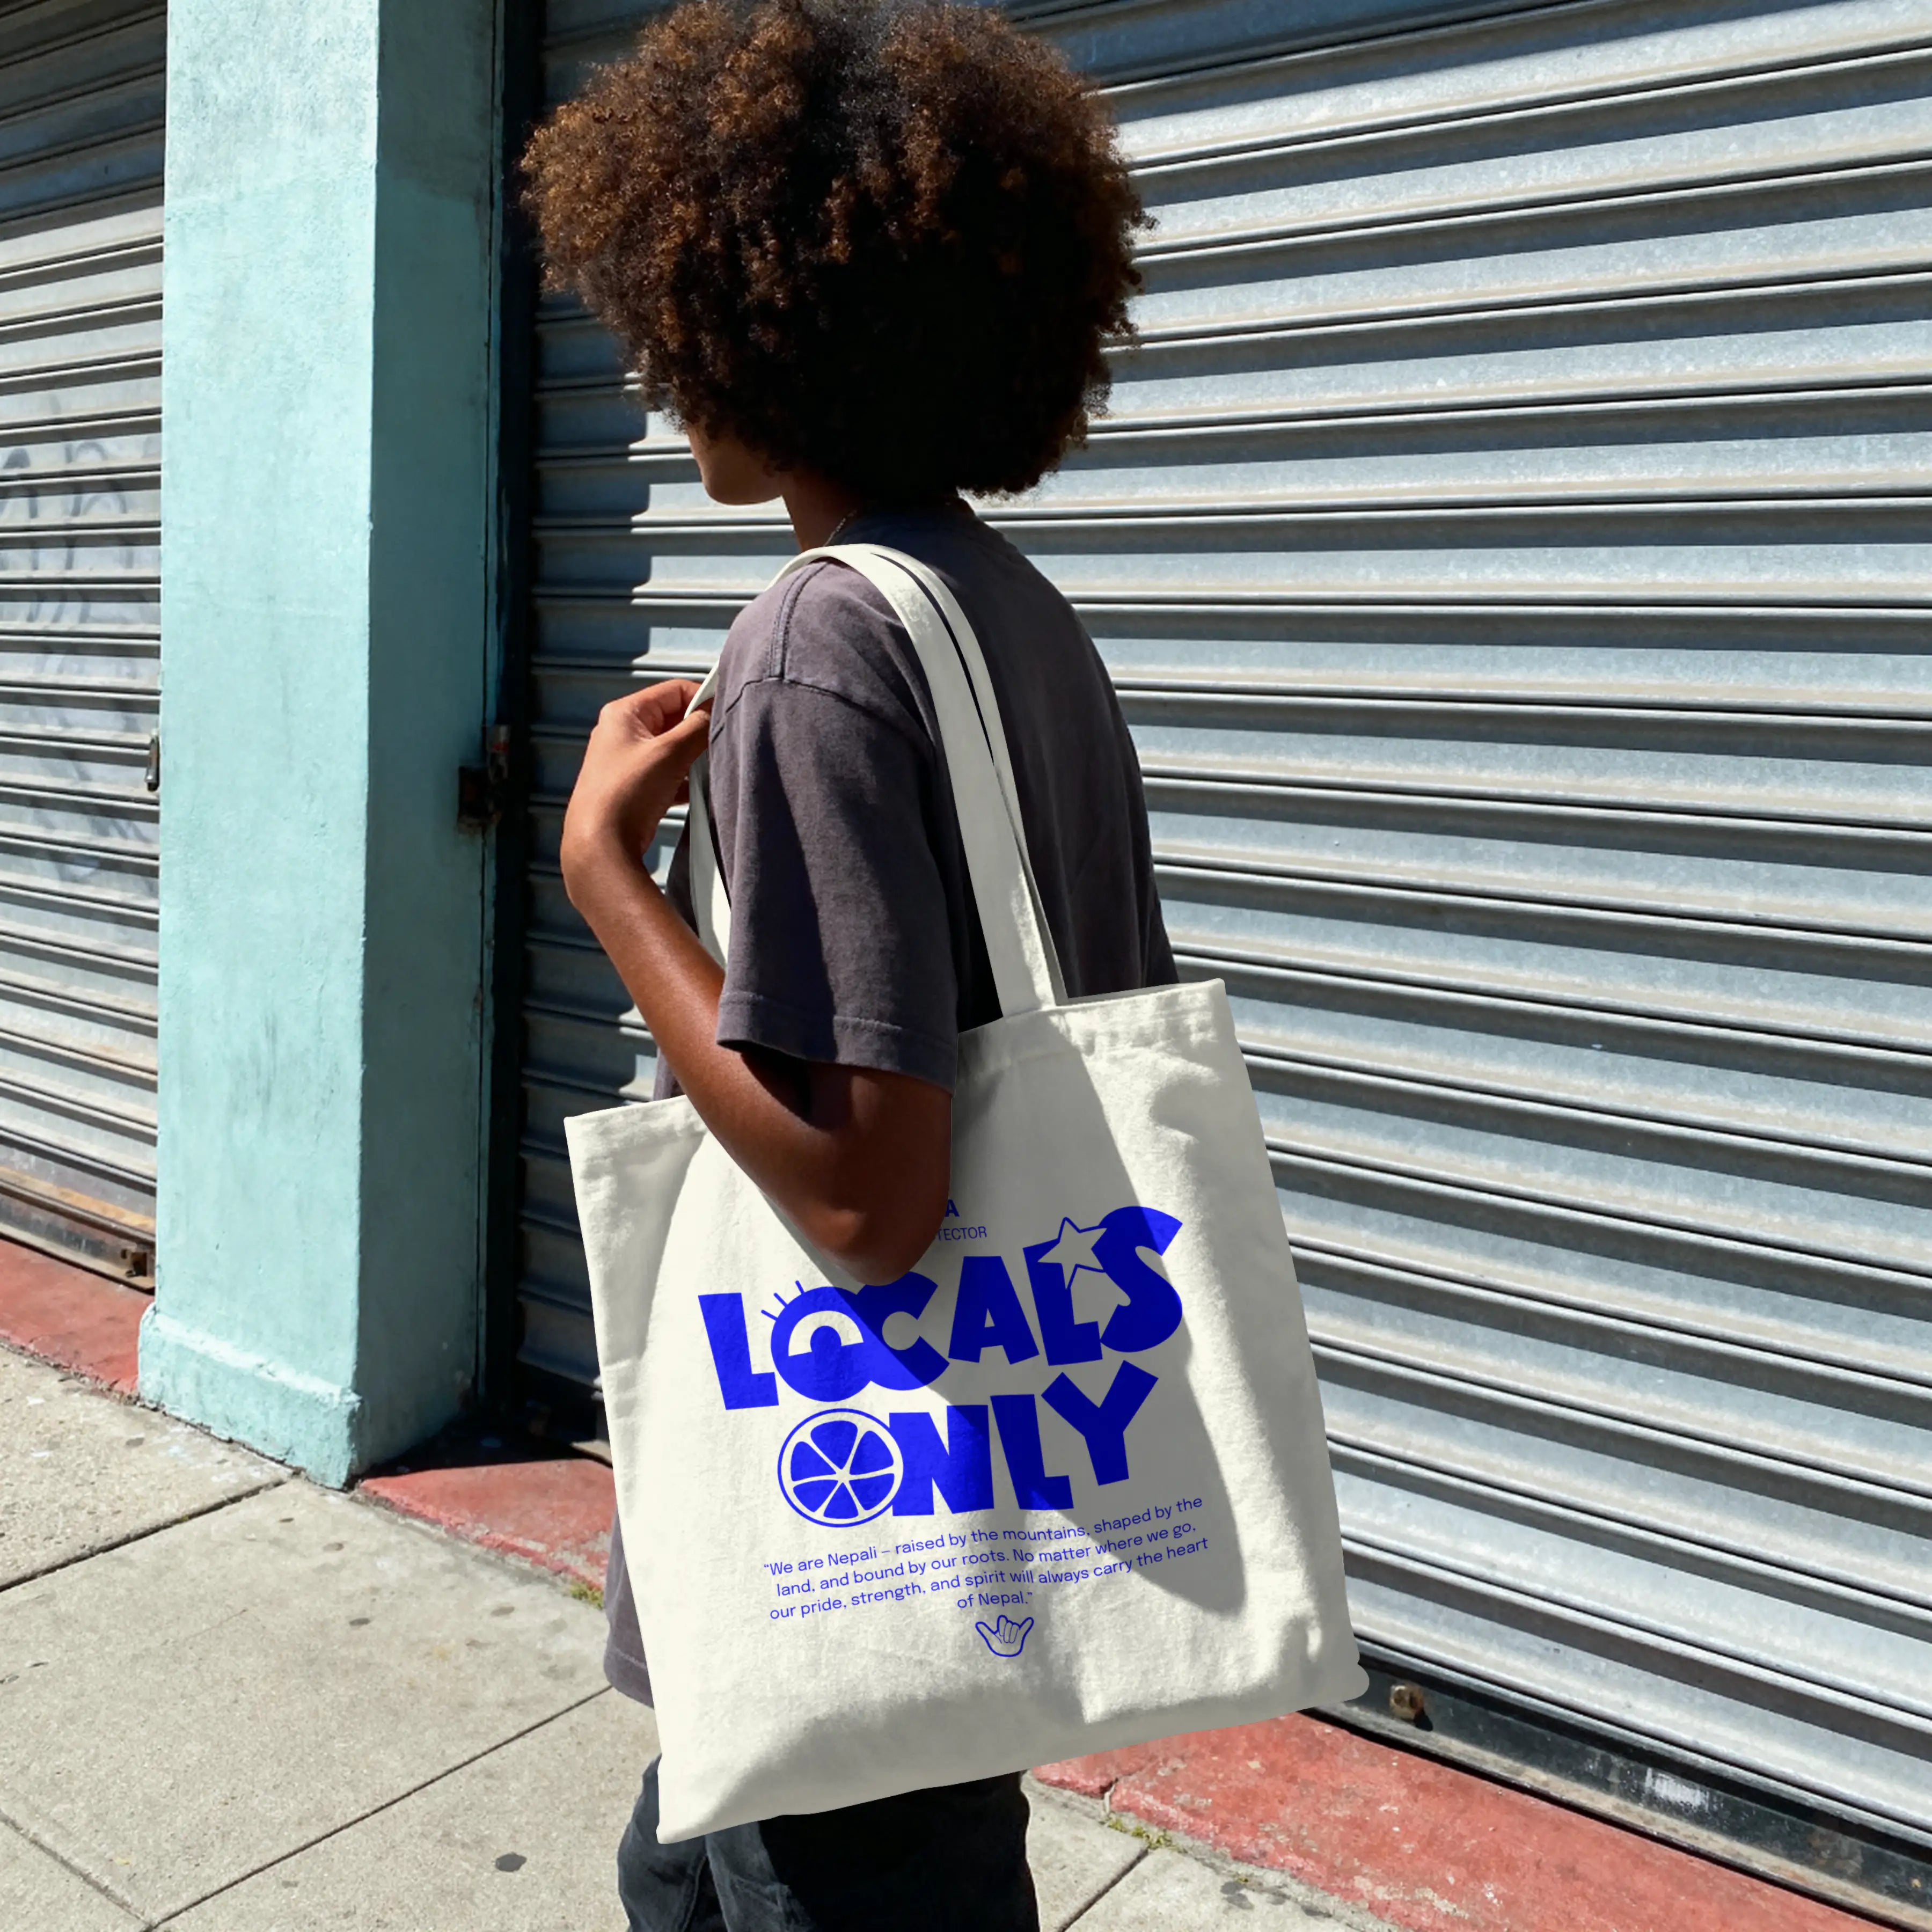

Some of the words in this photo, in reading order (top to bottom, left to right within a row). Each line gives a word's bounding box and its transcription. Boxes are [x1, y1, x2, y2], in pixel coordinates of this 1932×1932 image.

[697, 1205, 1183, 1411] LOCALS
[777, 1359, 1159, 1528] ONLY
[764, 1562, 793, 1576] “We
[798, 1558, 824, 1571] are
[828, 1546, 877, 1567] Nepali
[895, 1534, 945, 1554] raised
[948, 1533, 967, 1548] by
[970, 1529, 998, 1542] the
[1002, 1527, 1090, 1541] mountains,
[1094, 1508, 1151, 1533] shaped
[1154, 1506, 1172, 1520] by
[1176, 1498, 1203, 1512] the
[777, 1579, 815, 1597] land,
[819, 1572, 850, 1590] and
[853, 1562, 905, 1584] bound
[908, 1561, 926, 1576] by
[931, 1557, 957, 1570] our
[962, 1550, 1009, 1565] roots.
[1013, 1548, 1035, 1562] No
[1038, 1547, 1091, 1562] matter
[1095, 1536, 1143, 1555] where
[1147, 1529, 1168, 1542] we
[1173, 1523, 1196, 1539] go,
[770, 1606, 796, 1620] our
[800, 1597, 847, 1619] pride,
[851, 1582, 926, 1606] strength,
[930, 1575, 961, 1592] and
[964, 1571, 1005, 1588] spirit
[1009, 1570, 1034, 1583] will
[1038, 1569, 1089, 1584] always
[1093, 1560, 1132, 1577] carry
[1137, 1553, 1162, 1567] the
[1166, 1538, 1208, 1559] heart
[957, 1593, 974, 1609] of
[978, 1592, 1031, 1606] Nepal.”
